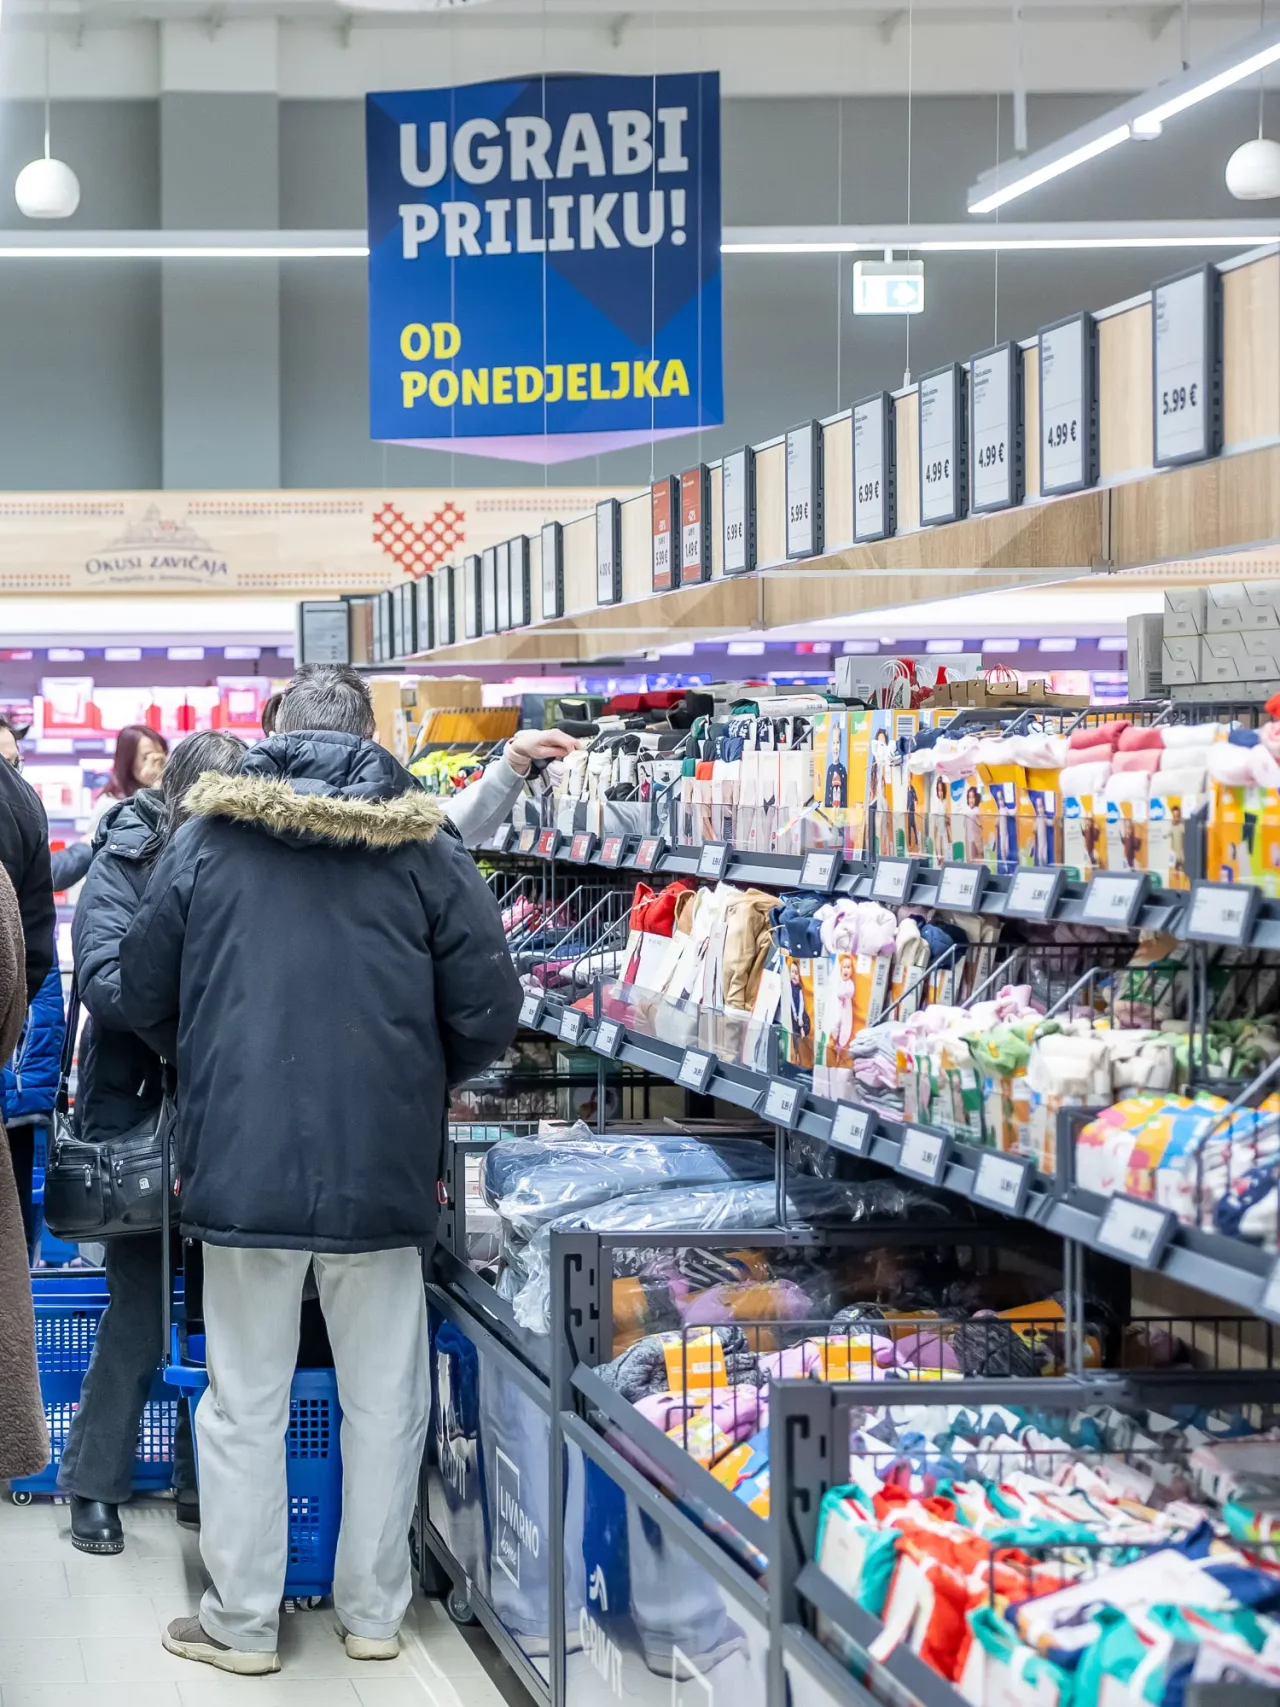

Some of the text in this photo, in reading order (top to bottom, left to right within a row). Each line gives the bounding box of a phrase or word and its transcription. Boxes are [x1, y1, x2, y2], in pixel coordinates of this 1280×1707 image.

[399, 106, 689, 188] UGRABI
[398, 189, 687, 259] PRILIKU!
[399, 322, 462, 361] OD
[400, 358, 690, 408] PONEDJELJKA
[1162, 383, 1198, 416] 5.99 €
[1047, 419, 1077, 448] 4.99 €
[925, 458, 950, 483] 4.99 €
[978, 442, 1005, 469] 4.99 €
[858, 480, 880, 503] 6.99 €
[790, 502, 809, 523] 5.99 €
[726, 521, 743, 542] 6.99 €
[500, 1485, 540, 1559] LIVARNO
